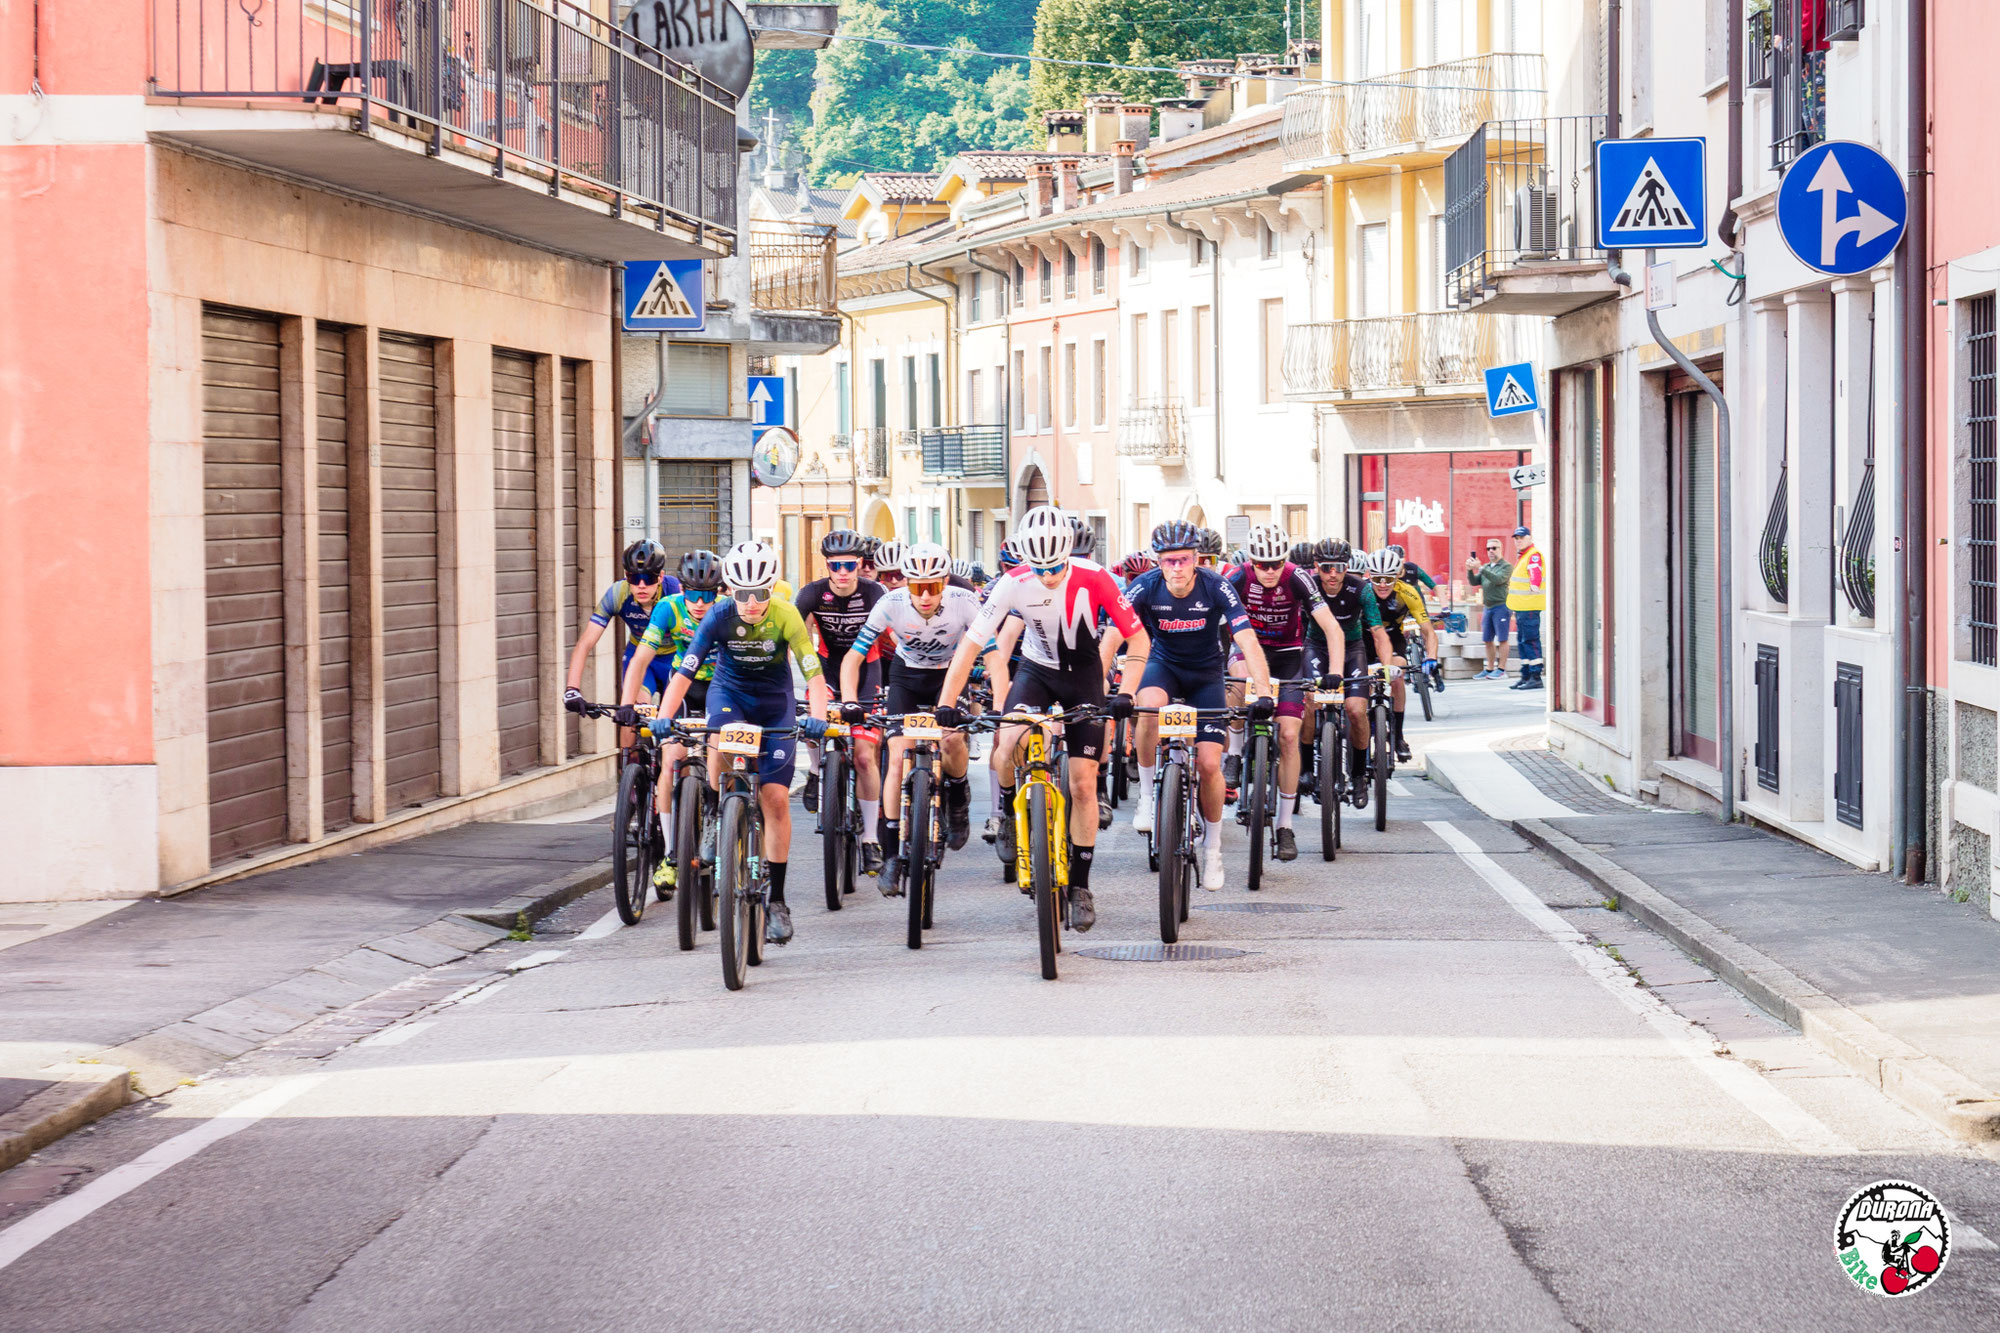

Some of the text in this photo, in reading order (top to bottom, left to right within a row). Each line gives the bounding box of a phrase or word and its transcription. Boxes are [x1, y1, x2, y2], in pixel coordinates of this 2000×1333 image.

[630, 518, 641, 526] 29
[1158, 618, 1206, 631] Todesco
[909, 716, 936, 728] 527
[1164, 712, 1191, 725] 634
[725, 731, 755, 744] 523
